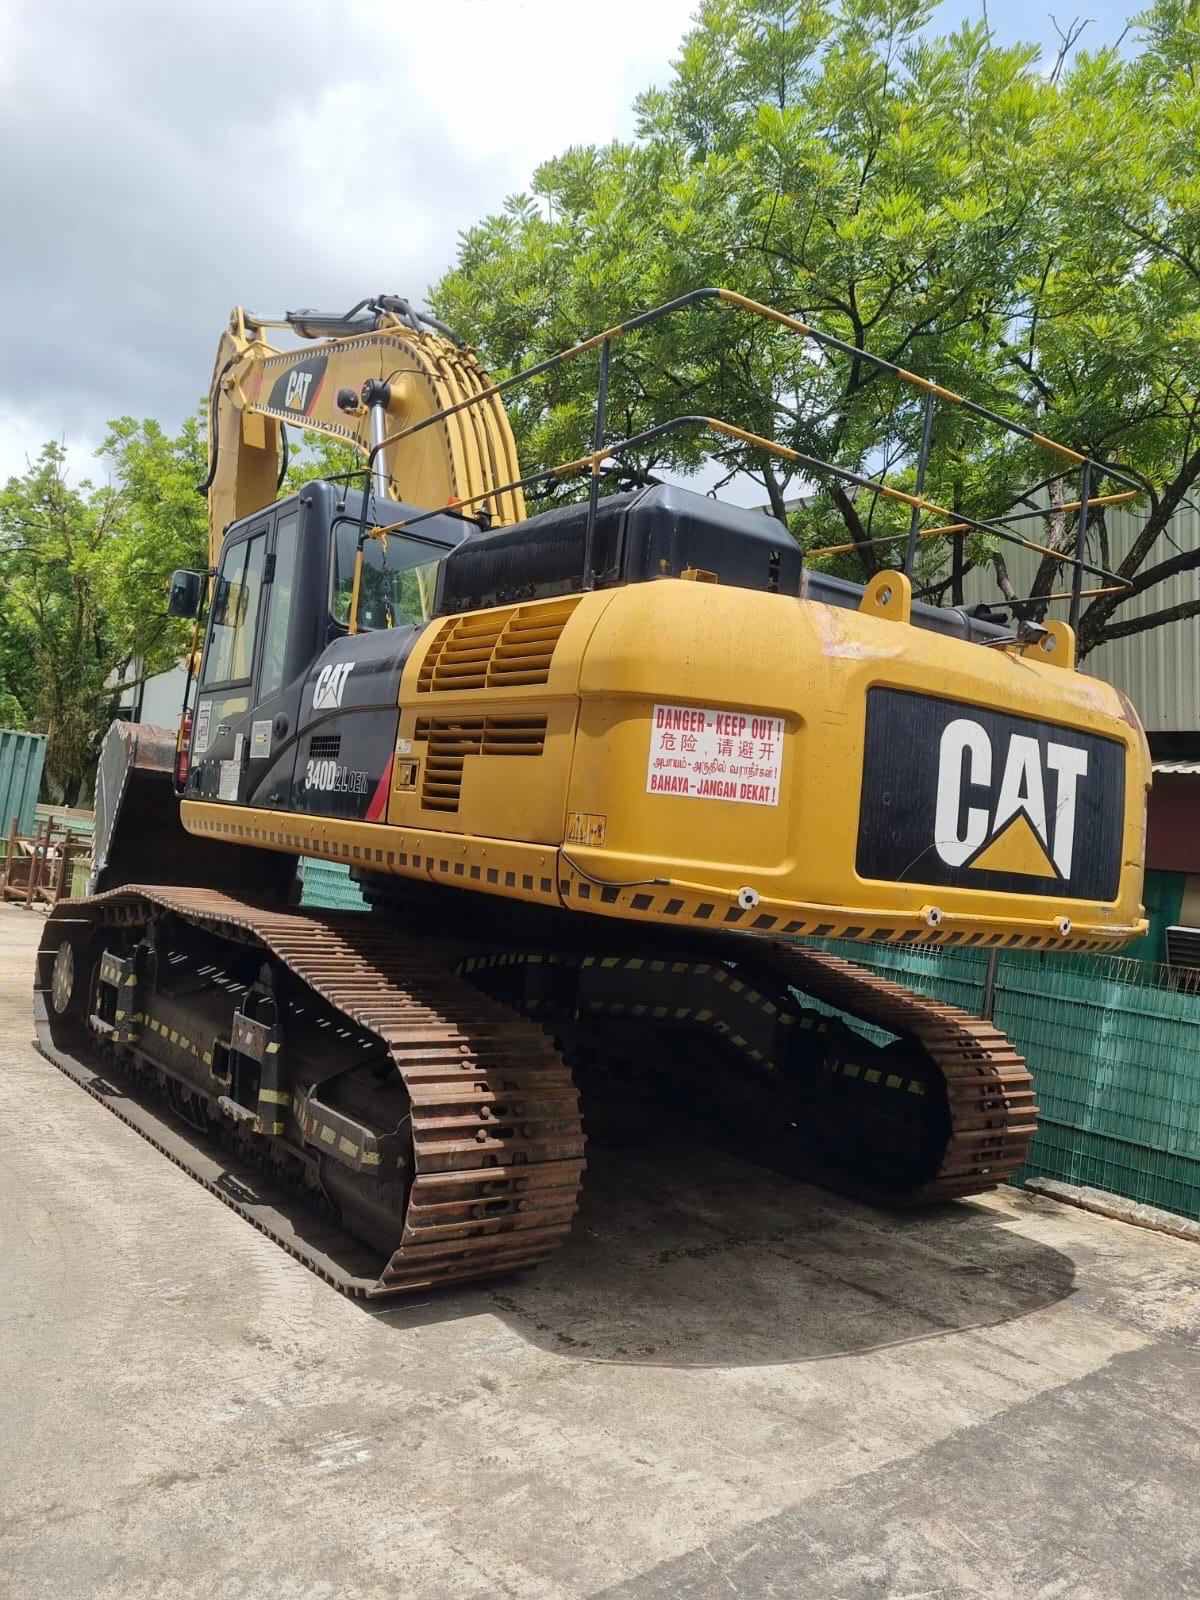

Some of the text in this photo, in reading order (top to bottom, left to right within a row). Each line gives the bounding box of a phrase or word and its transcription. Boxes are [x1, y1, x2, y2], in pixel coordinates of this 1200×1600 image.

[285, 370, 313, 411] CAT
[313, 662, 355, 710] CAT
[934, 718, 1088, 880] CAT
